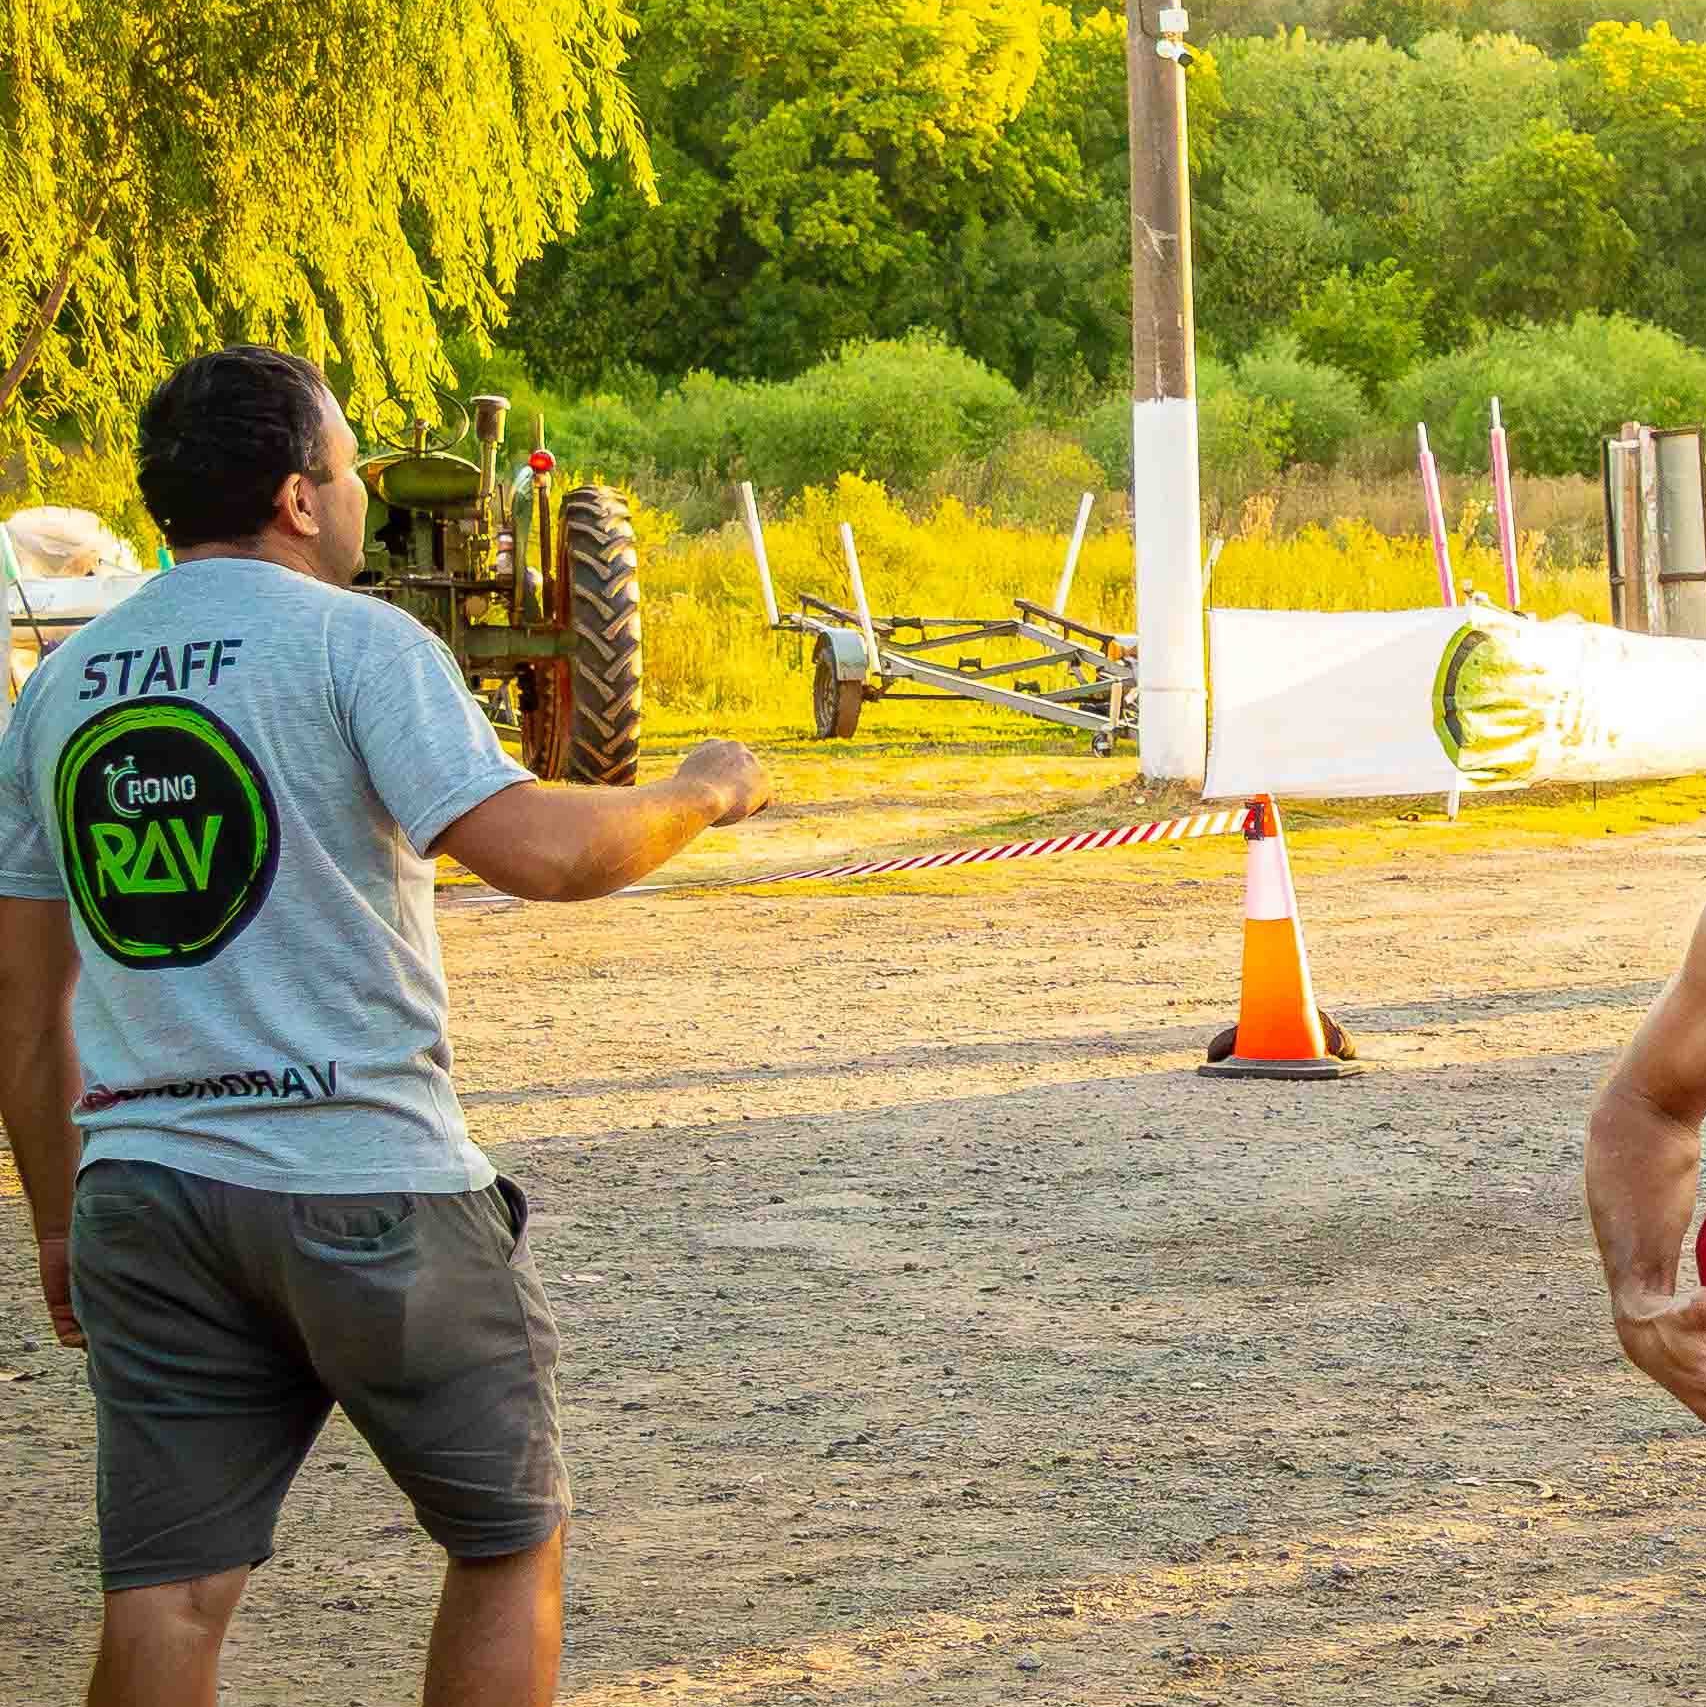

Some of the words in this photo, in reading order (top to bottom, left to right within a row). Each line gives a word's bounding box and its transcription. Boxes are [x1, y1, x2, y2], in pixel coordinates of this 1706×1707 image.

[78, 638, 243, 700] STAFF
[107, 757, 196, 819] CRONO
[89, 814, 224, 898] RAV
